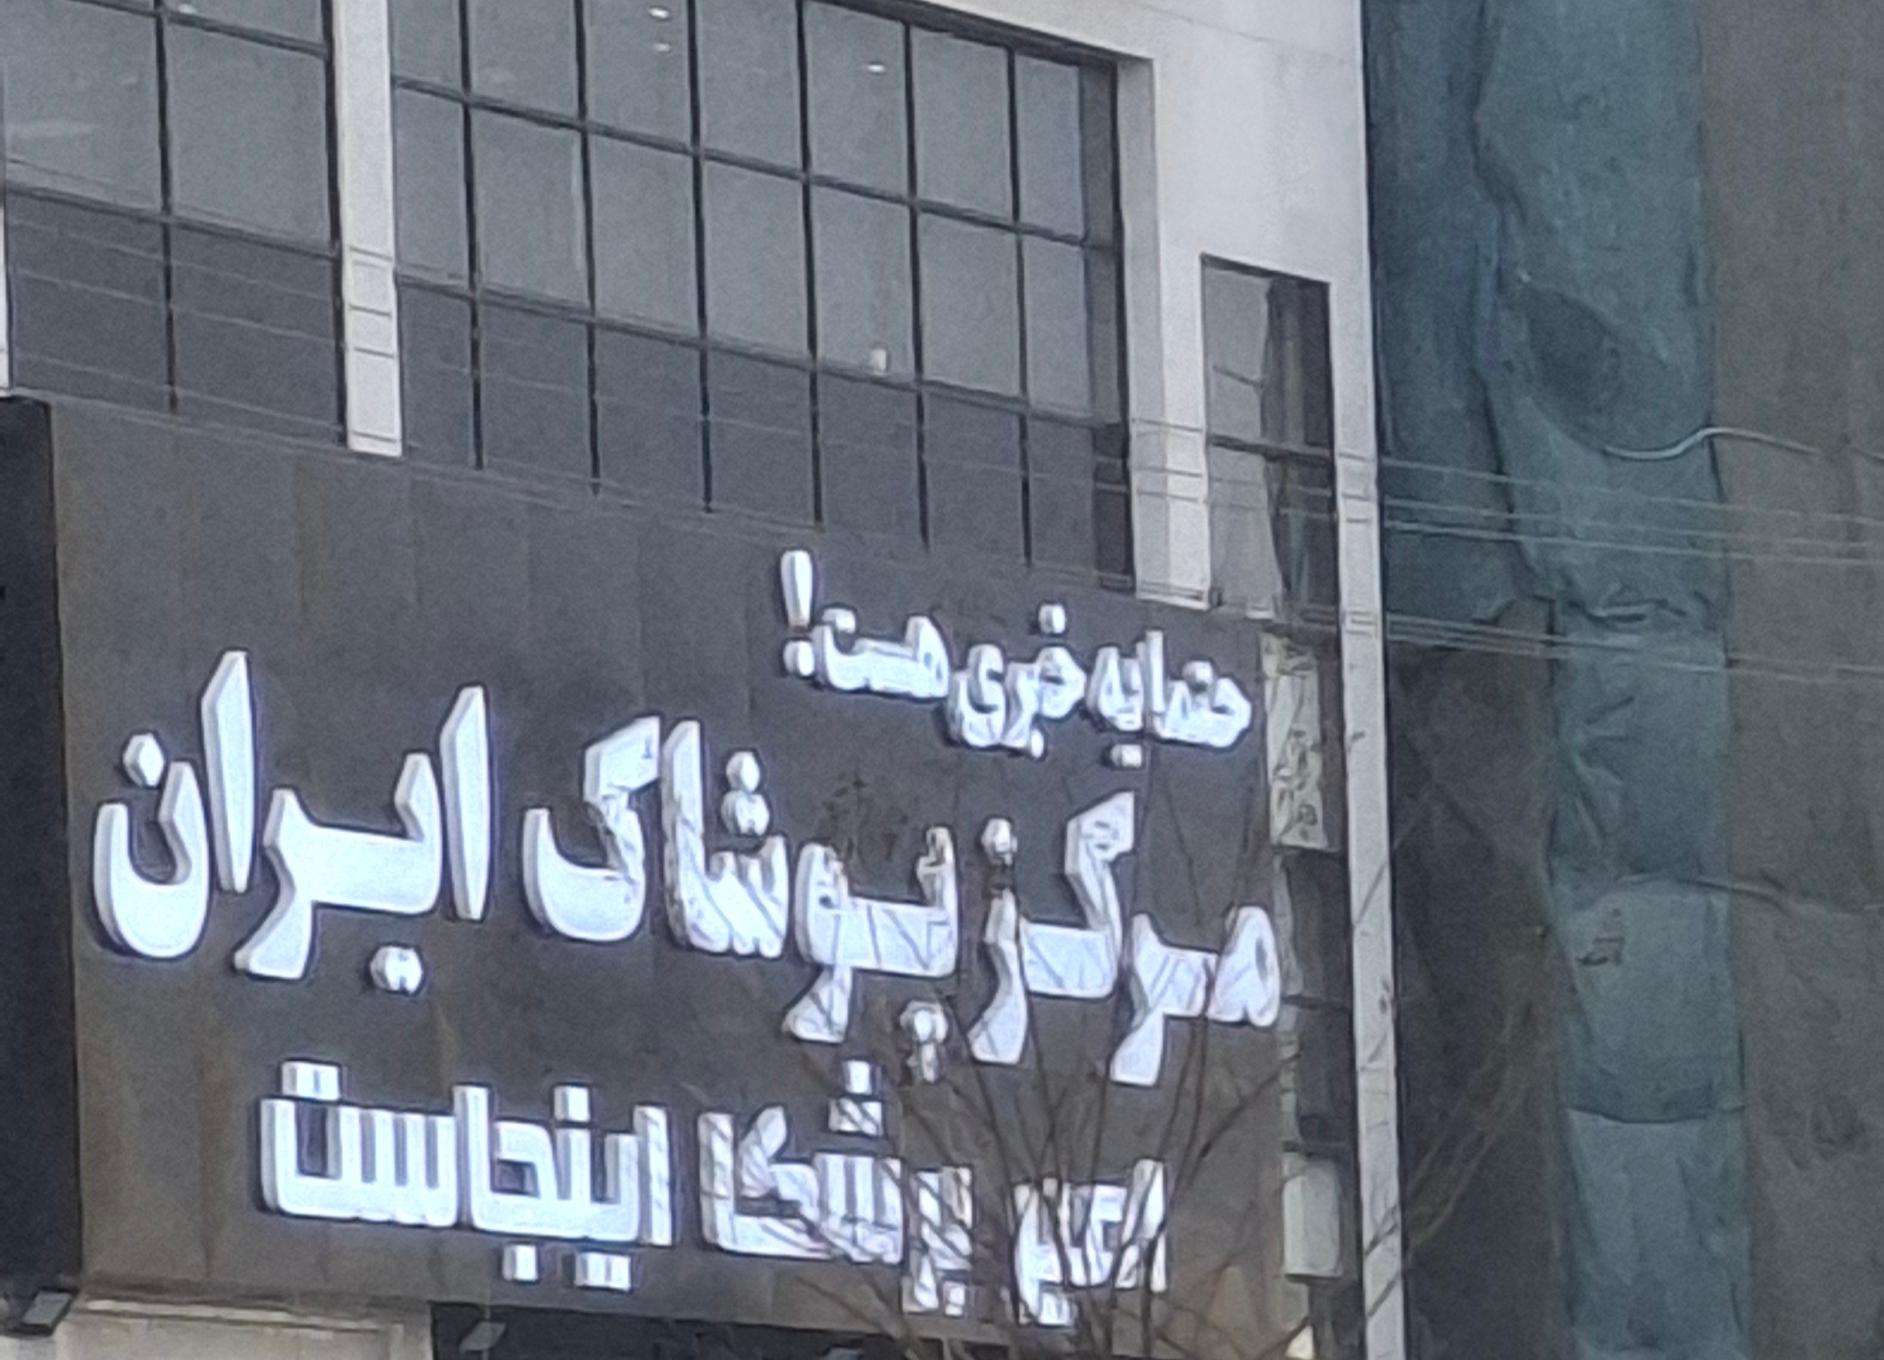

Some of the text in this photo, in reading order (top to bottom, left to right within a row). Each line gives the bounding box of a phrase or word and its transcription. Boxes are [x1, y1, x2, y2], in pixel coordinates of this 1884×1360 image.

[947, 602, 1088, 761] خبری
[93, 650, 1282, 1087] مرکز پوشاک ایران
[260, 1059, 674, 1292] اینجاست
